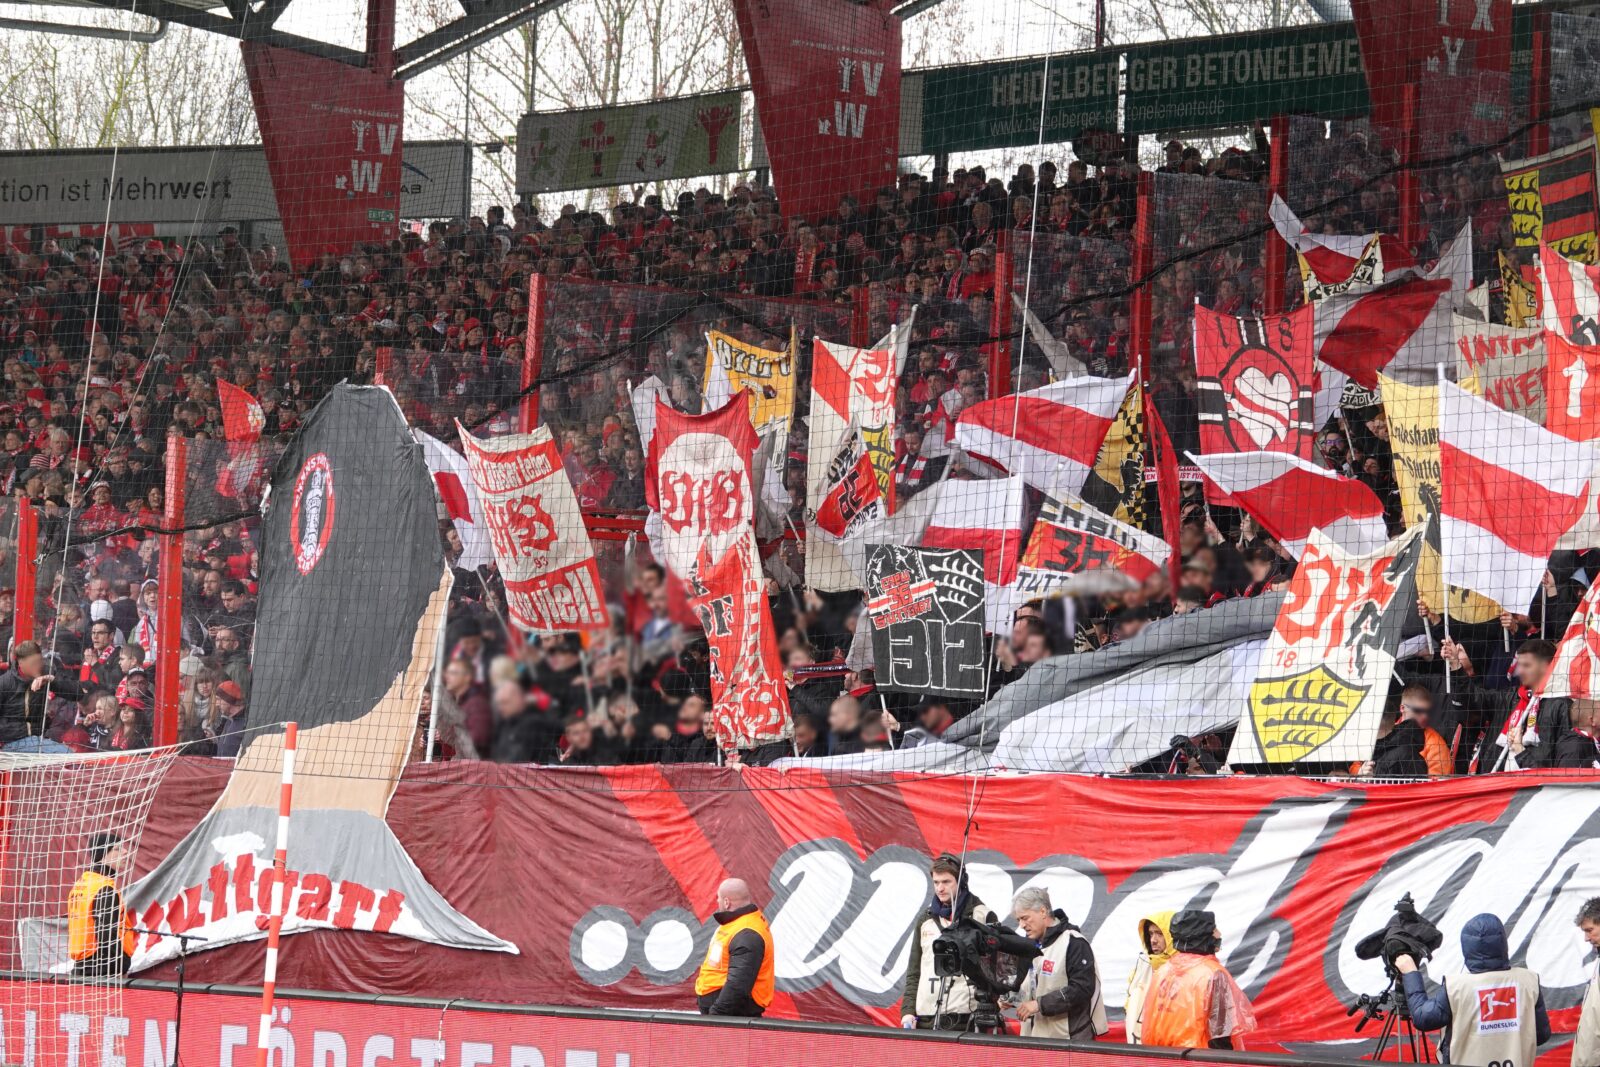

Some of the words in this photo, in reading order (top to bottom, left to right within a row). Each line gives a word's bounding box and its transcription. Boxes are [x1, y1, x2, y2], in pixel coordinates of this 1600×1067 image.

[992, 54, 1178, 108] HEIDELBERGER
[60, 177, 91, 202] ist
[102, 175, 232, 201] Mehrwert
[1275, 649, 1298, 669] 18
[1480, 1021, 1518, 1031] BUNDESLIGA
